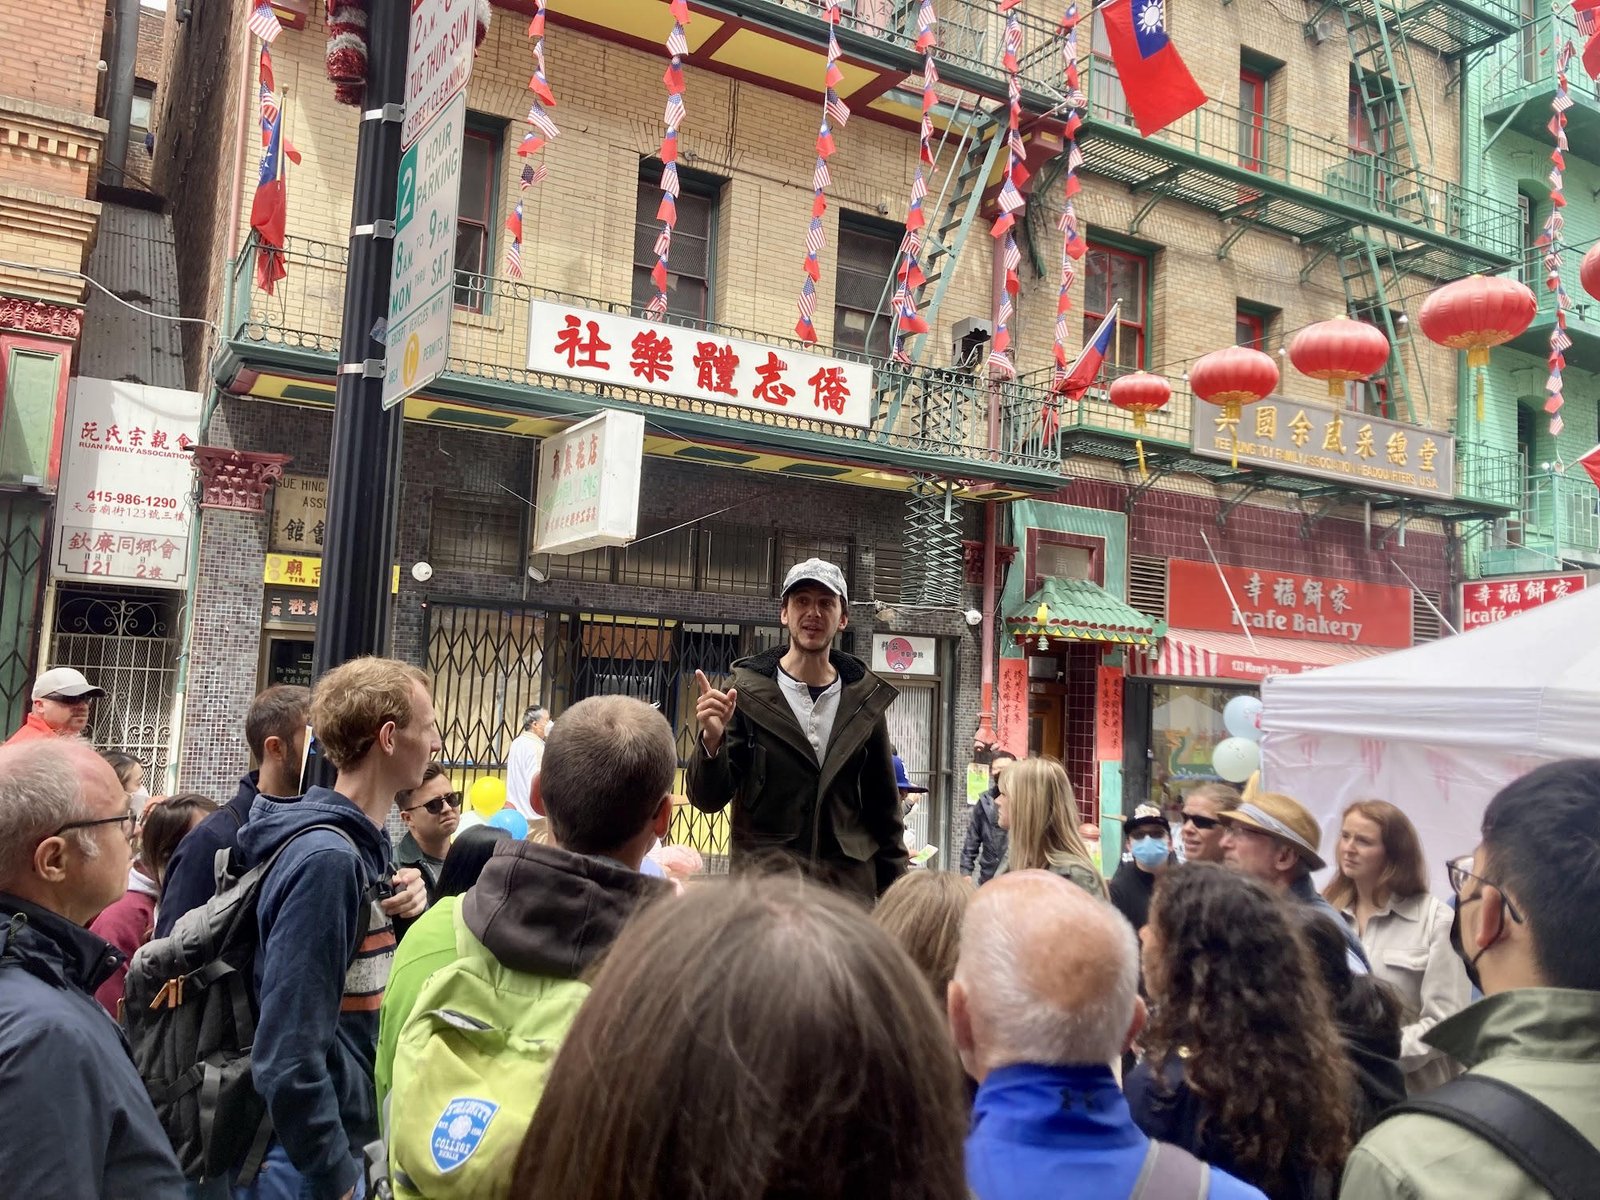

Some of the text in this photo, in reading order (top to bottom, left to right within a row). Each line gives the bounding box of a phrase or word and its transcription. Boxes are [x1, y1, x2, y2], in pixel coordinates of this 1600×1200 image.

[410, 61, 425, 102] TUE
[426, 33, 448, 84] THUR
[450, 6, 470, 55] SUN
[414, 14, 422, 54] 2
[407, 58, 466, 138] STREET CLEANING
[424, 121, 452, 172] HOUR
[400, 166, 413, 221] 2
[416, 147, 458, 212] PARKING
[396, 240, 404, 279] 8
[417, 233, 424, 248] TO
[429, 209, 437, 249] 9
[392, 280, 412, 318] MON
[431, 248, 449, 286] SAT
[79, 441, 194, 460] RUAN FAMILY ASSOCIATION
[87, 490, 177, 509] 415-986-1290
[83, 560, 112, 577] 121
[1243, 572, 1353, 615] 幸福餅家
[1472, 579, 1573, 606] 幸福餅家
[1292, 612, 1363, 641] Bakery
[434, 1136, 472, 1155] COLLEGE
